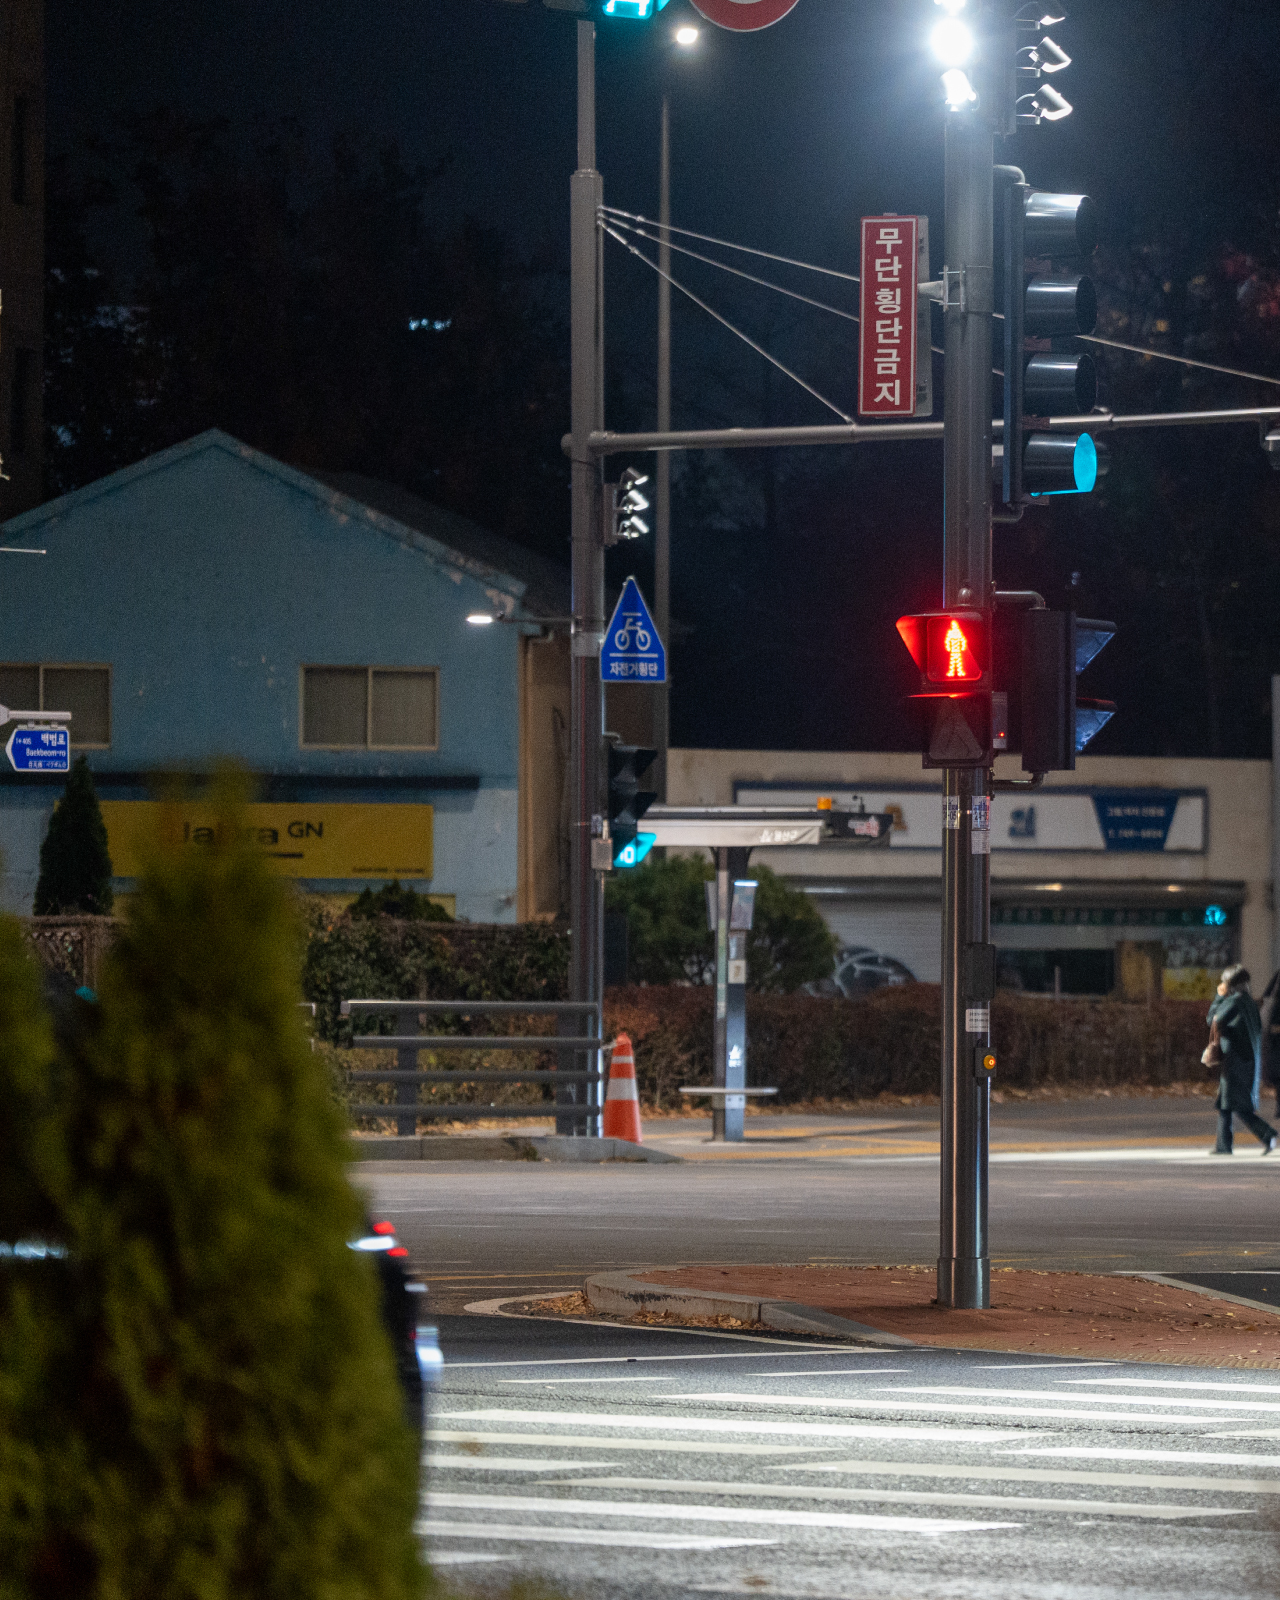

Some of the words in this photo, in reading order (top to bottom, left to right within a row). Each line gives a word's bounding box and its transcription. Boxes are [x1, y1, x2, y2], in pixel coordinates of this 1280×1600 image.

[873, 227, 903, 406] 무단횡단금지
[610, 662, 658, 677] 자전거횡단
[41, 733, 66, 746] 백범로
[26, 748, 66, 757] Baekbeom-ro
[181, 821, 279, 847] Jaa
[287, 820, 324, 839] GN
